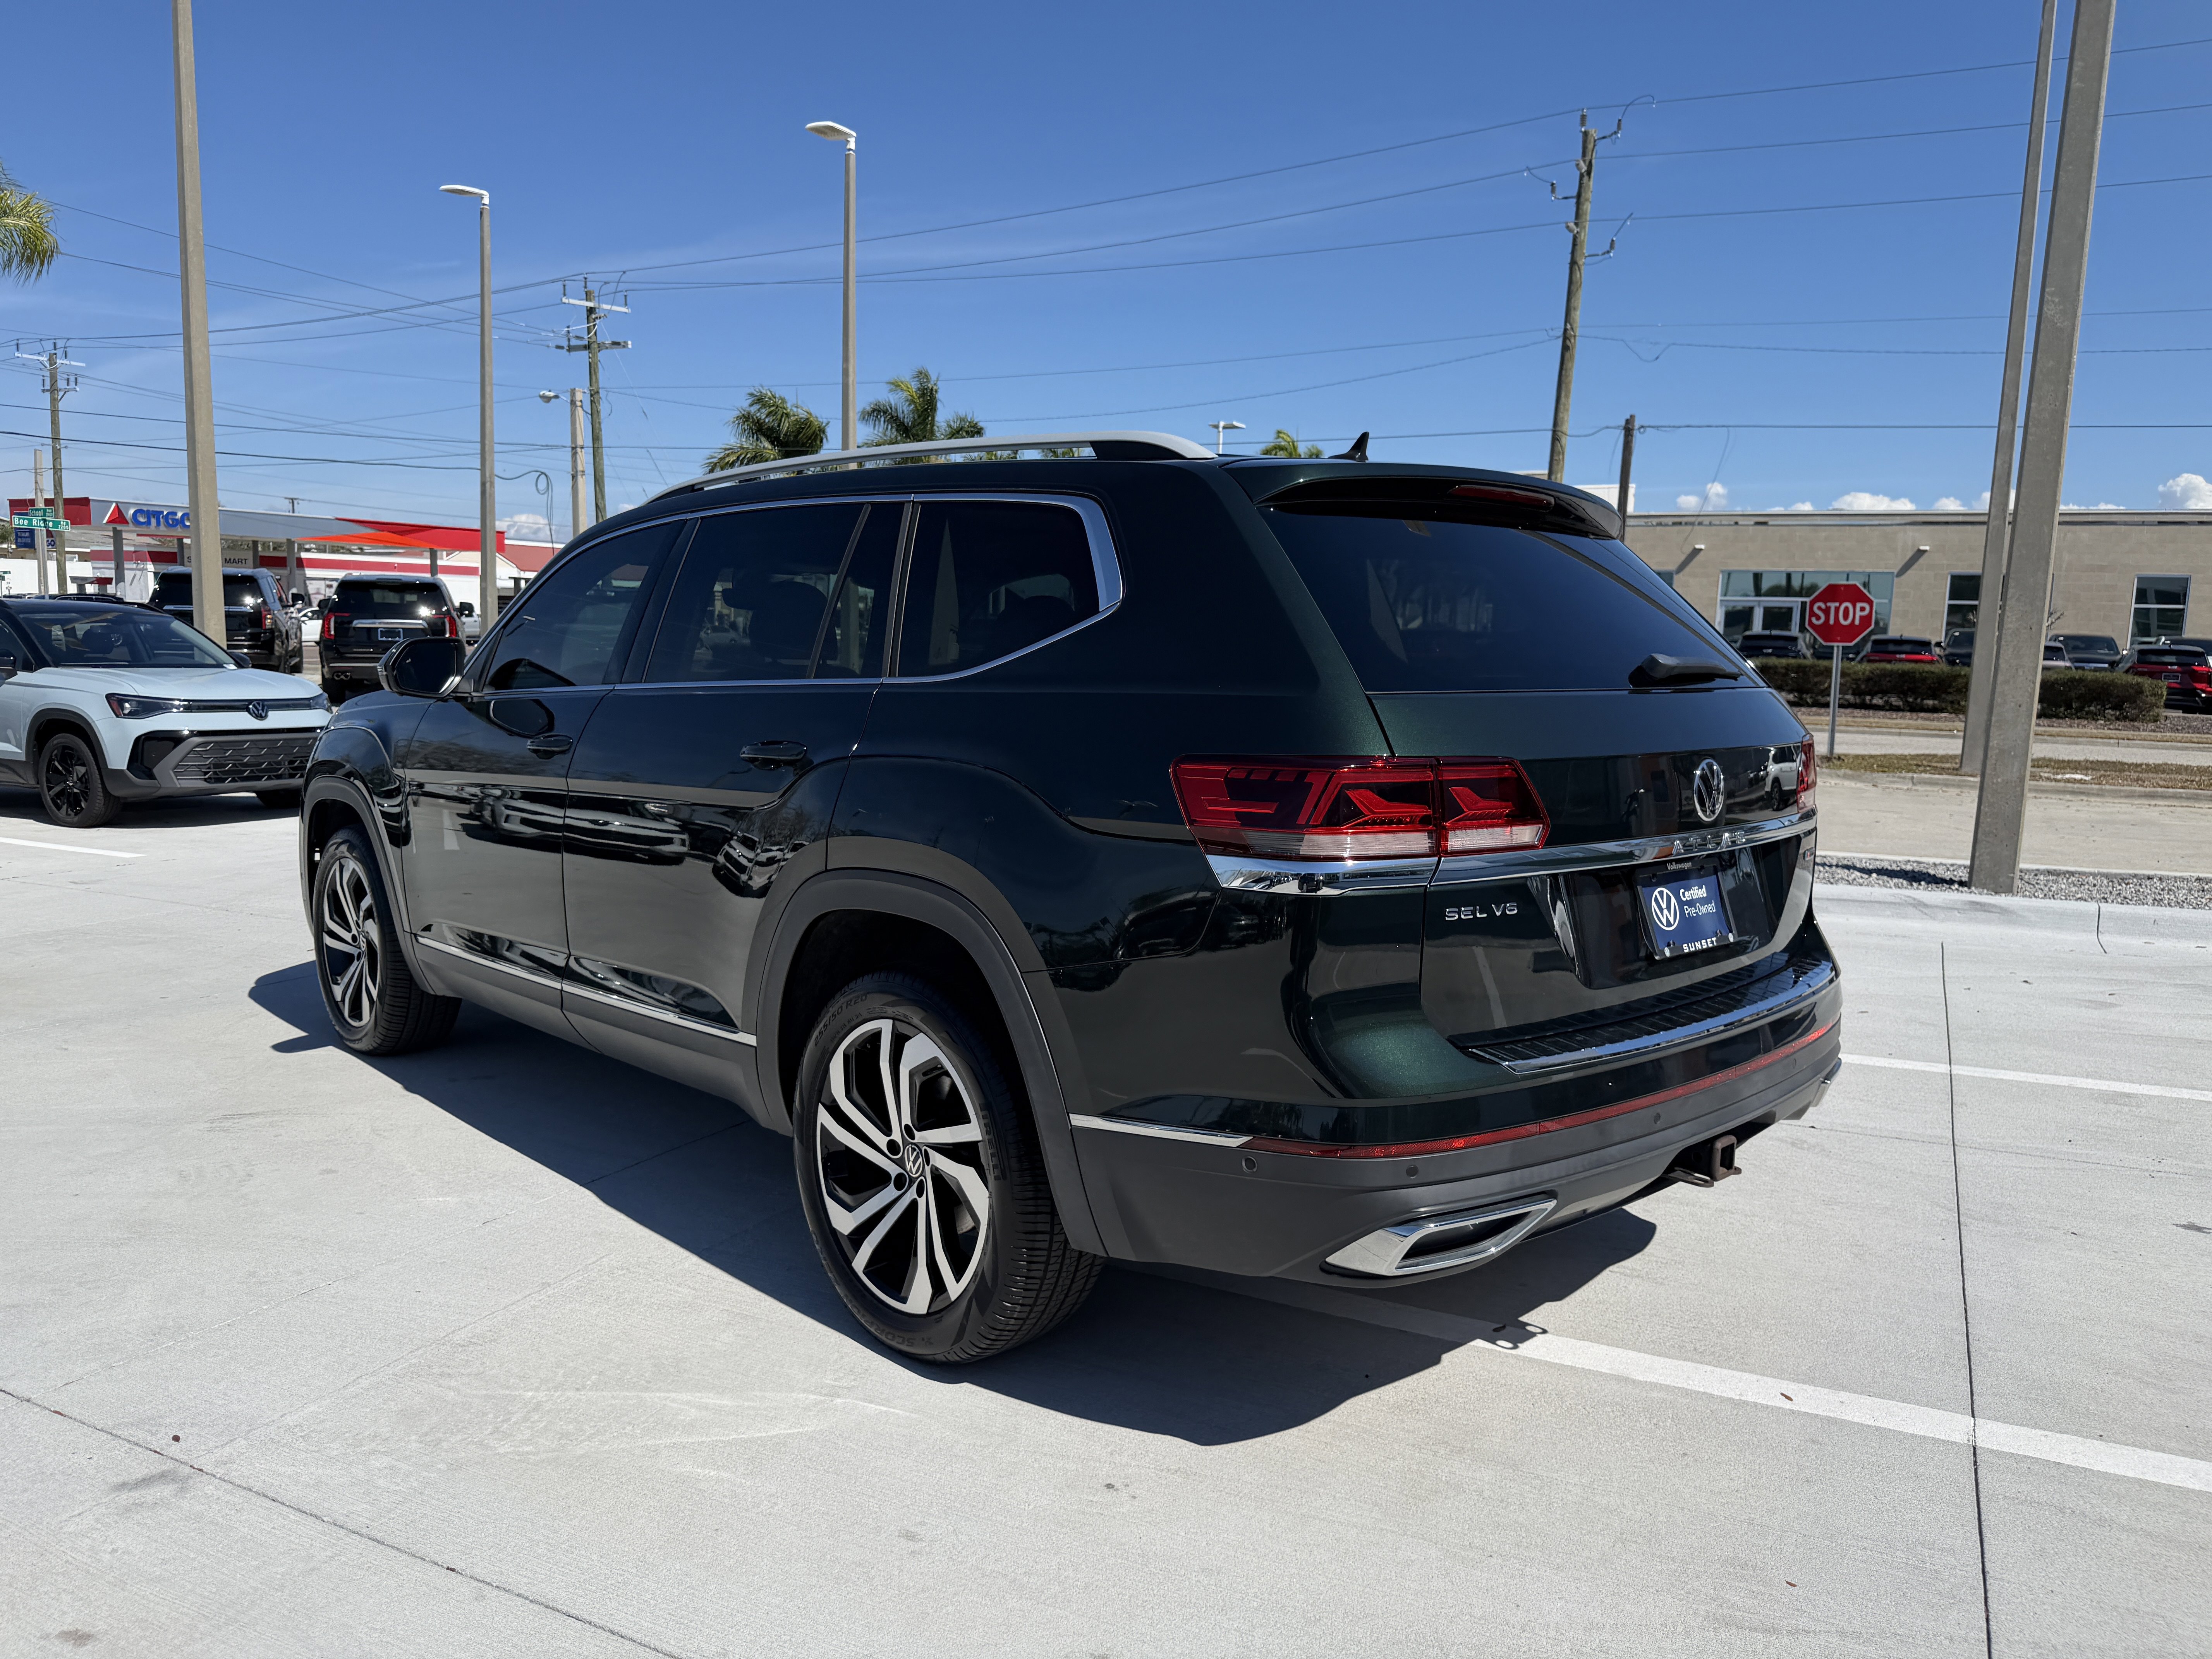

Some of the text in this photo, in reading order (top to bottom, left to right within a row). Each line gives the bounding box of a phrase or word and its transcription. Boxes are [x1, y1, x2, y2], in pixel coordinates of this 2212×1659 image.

[1811, 602, 1870, 625] STOP
[1671, 831, 1745, 855] ATLAS
[1667, 862, 1692, 870] Volkswagen
[1680, 885, 1707, 901] Certified
[1445, 902, 1518, 920] SEL V6
[1684, 900, 1716, 917] Pre-Owned
[1683, 937, 1716, 953] SUNSET
[845, 993, 867, 1010] R20
